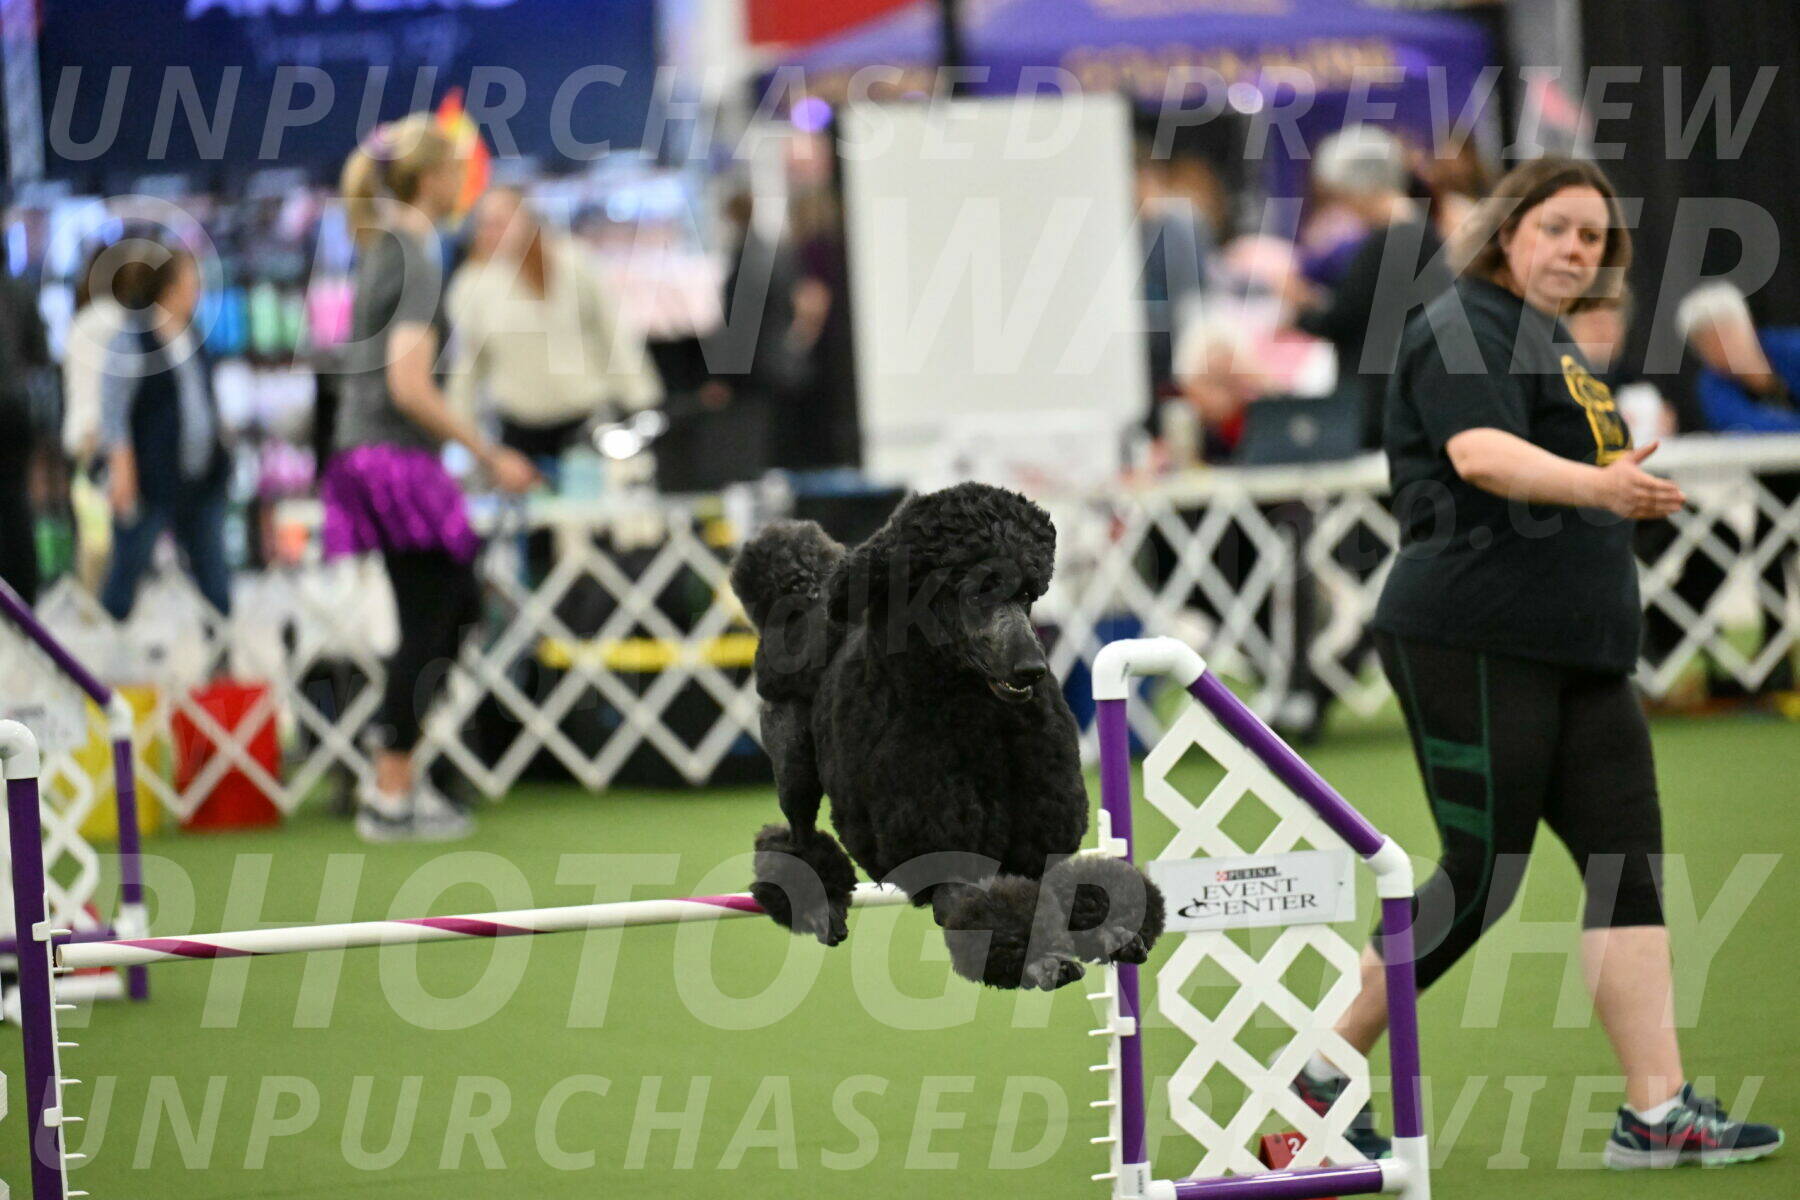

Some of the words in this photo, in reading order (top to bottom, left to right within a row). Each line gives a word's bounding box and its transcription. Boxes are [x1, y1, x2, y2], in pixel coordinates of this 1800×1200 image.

[1203, 877, 1299, 901] EVENT
[1177, 893, 1318, 919] CENTER
[1288, 1137, 1301, 1156] 2
